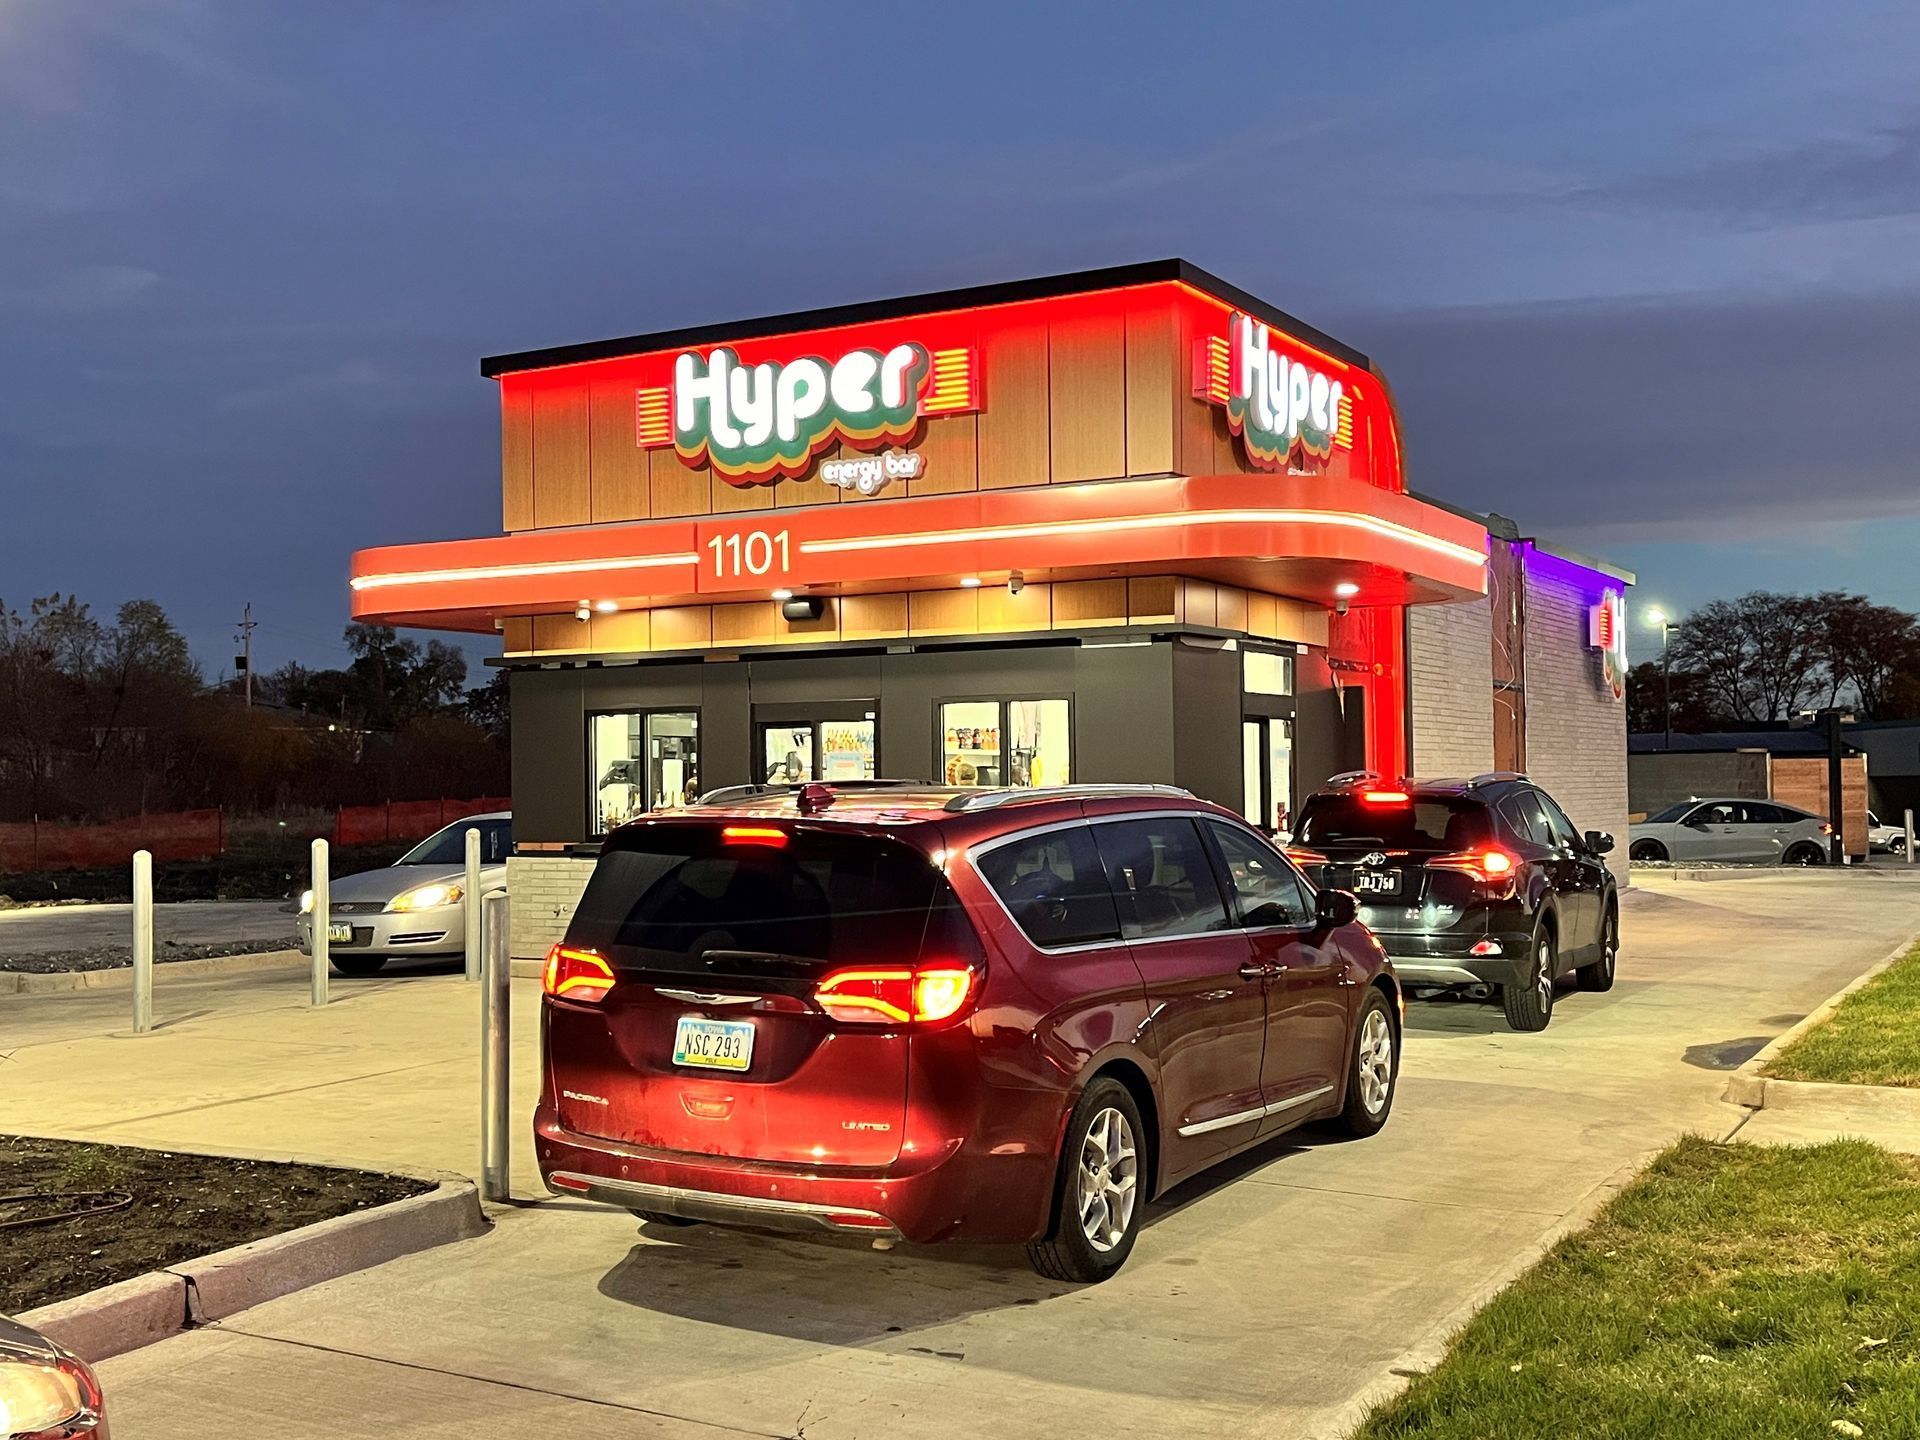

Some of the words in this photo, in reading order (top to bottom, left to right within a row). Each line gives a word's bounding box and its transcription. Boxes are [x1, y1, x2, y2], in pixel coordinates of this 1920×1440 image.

[675, 344, 915, 449] Hyper
[1242, 315, 1342, 438] Hyper
[823, 460, 882, 490] energy
[886, 454, 918, 474] bar
[708, 529, 790, 577] 1101
[684, 1033, 711, 1056] NSC
[714, 1036, 741, 1059] 293
